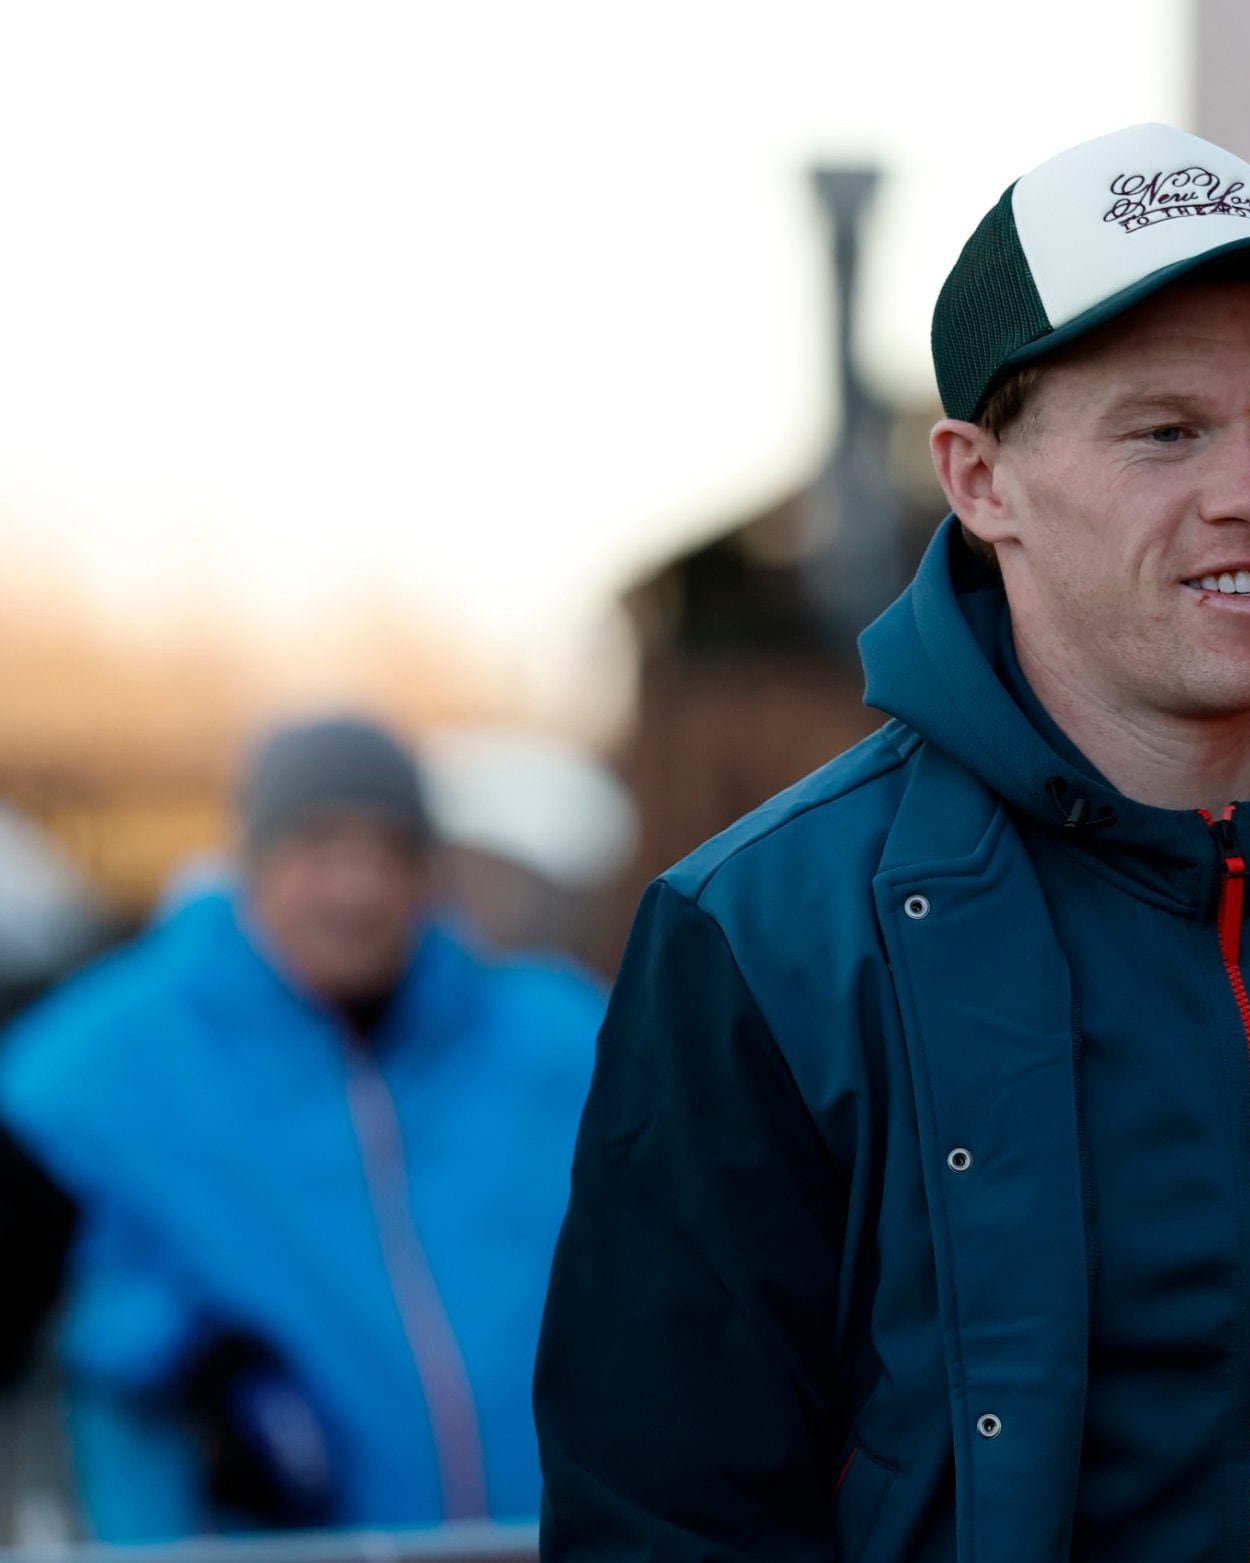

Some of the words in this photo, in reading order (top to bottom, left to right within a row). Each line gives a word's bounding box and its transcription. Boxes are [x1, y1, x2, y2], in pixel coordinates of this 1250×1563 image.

[1104, 171, 1199, 218] New
[1119, 214, 1150, 231] TO
[1161, 205, 1207, 217] THE
